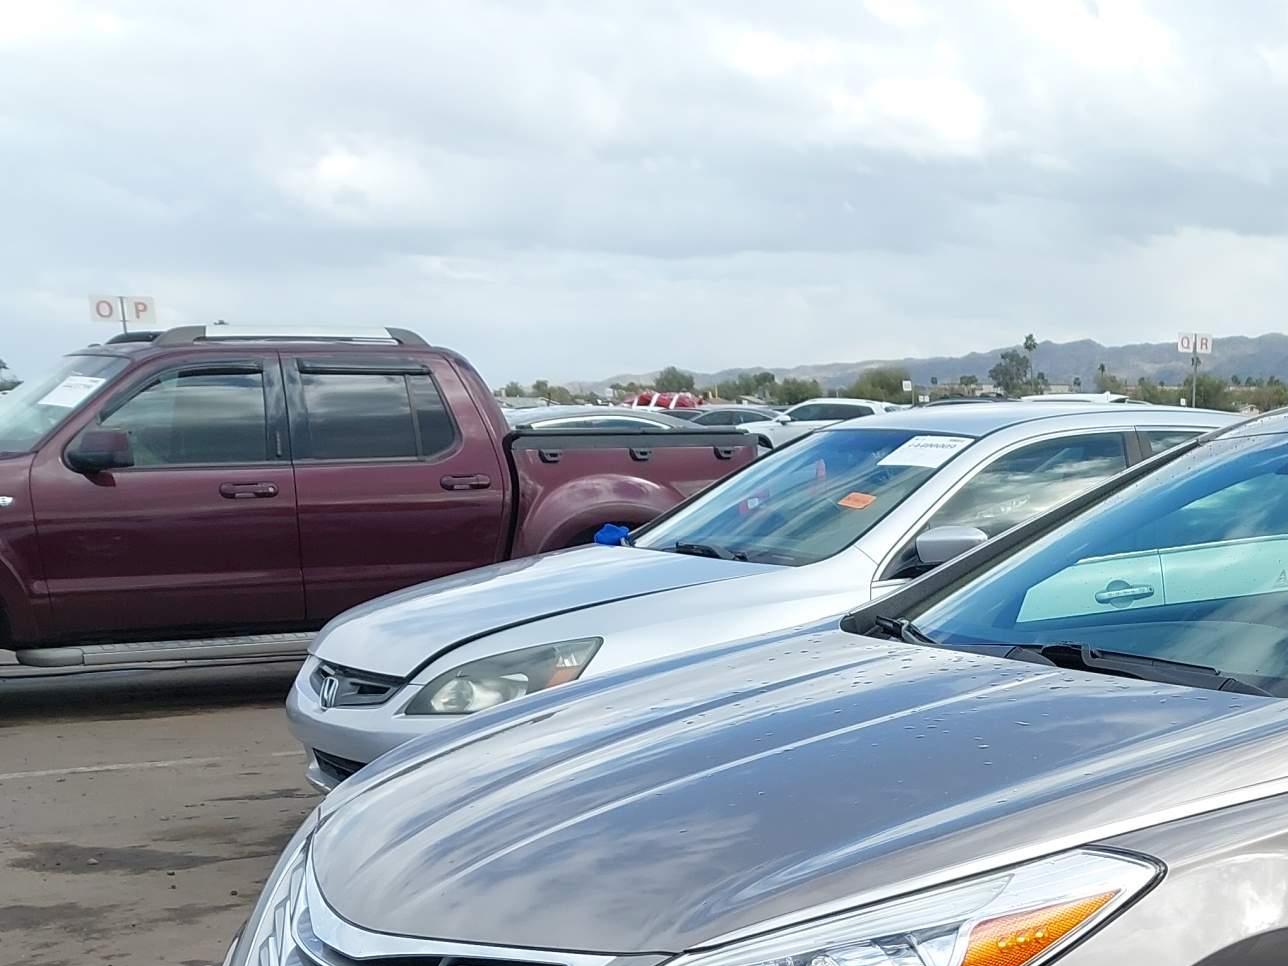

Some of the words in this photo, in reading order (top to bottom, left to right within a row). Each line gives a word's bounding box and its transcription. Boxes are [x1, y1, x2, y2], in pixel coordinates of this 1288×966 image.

[96, 300, 113, 318] O
[134, 302, 147, 319] P
[1181, 336, 1191, 350] Q
[1200, 336, 1208, 350] R
